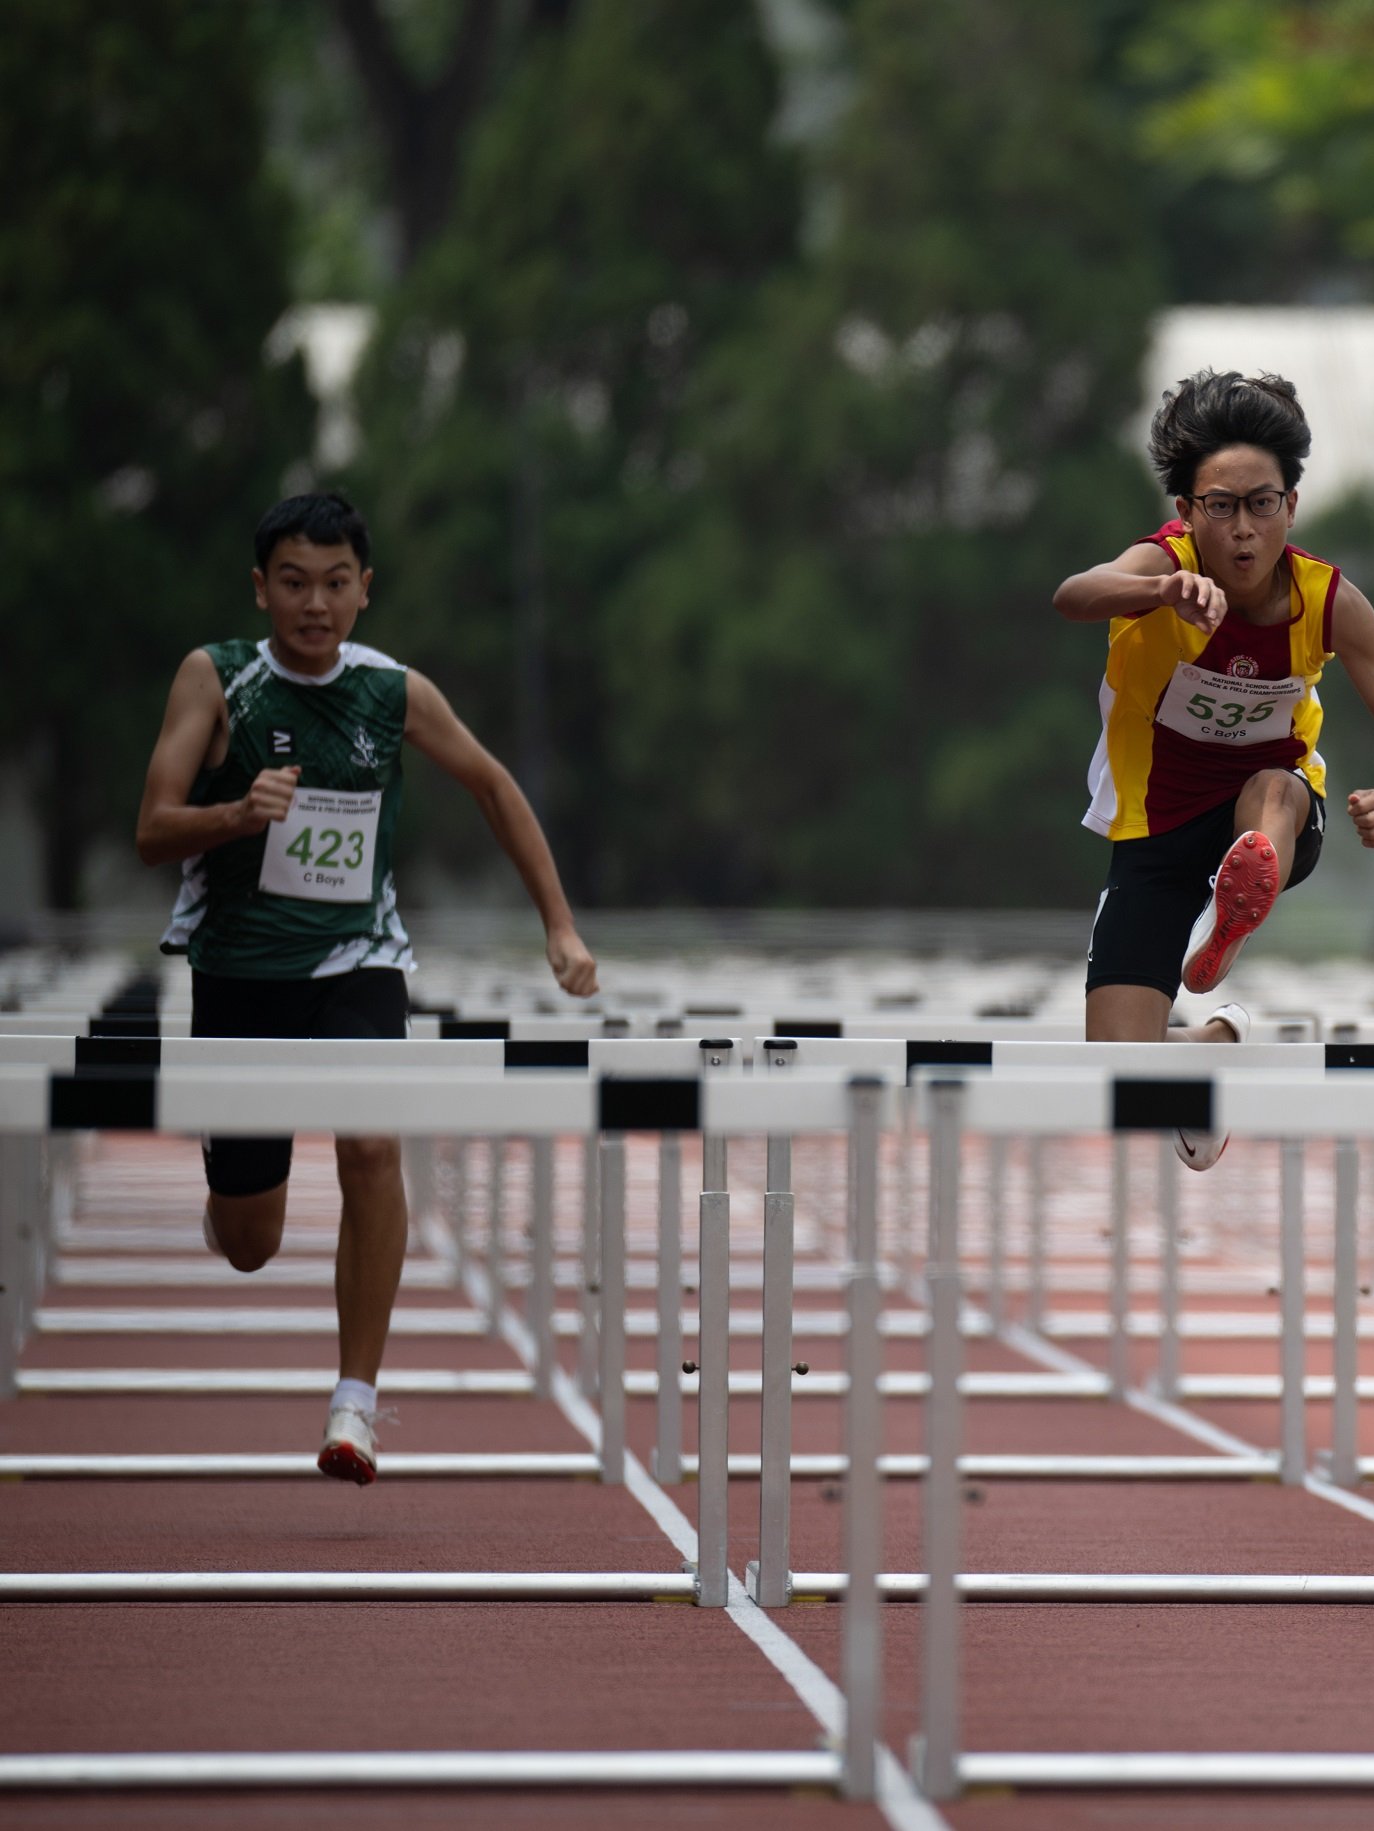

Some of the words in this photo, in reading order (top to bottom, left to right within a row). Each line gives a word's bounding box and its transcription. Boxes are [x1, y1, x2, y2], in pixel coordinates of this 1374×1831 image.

[1201, 679, 1221, 689] TRACK
[1249, 687, 1301, 695] CHAMPIONSHIPS
[1212, 677, 1242, 686] NATIONAL
[1272, 682, 1294, 690] GAMES
[1186, 693, 1278, 728] 535
[1214, 729, 1246, 739] Boys
[286, 827, 364, 869] 423
[303, 872, 312, 882] C
[316, 873, 345, 887] Boys
